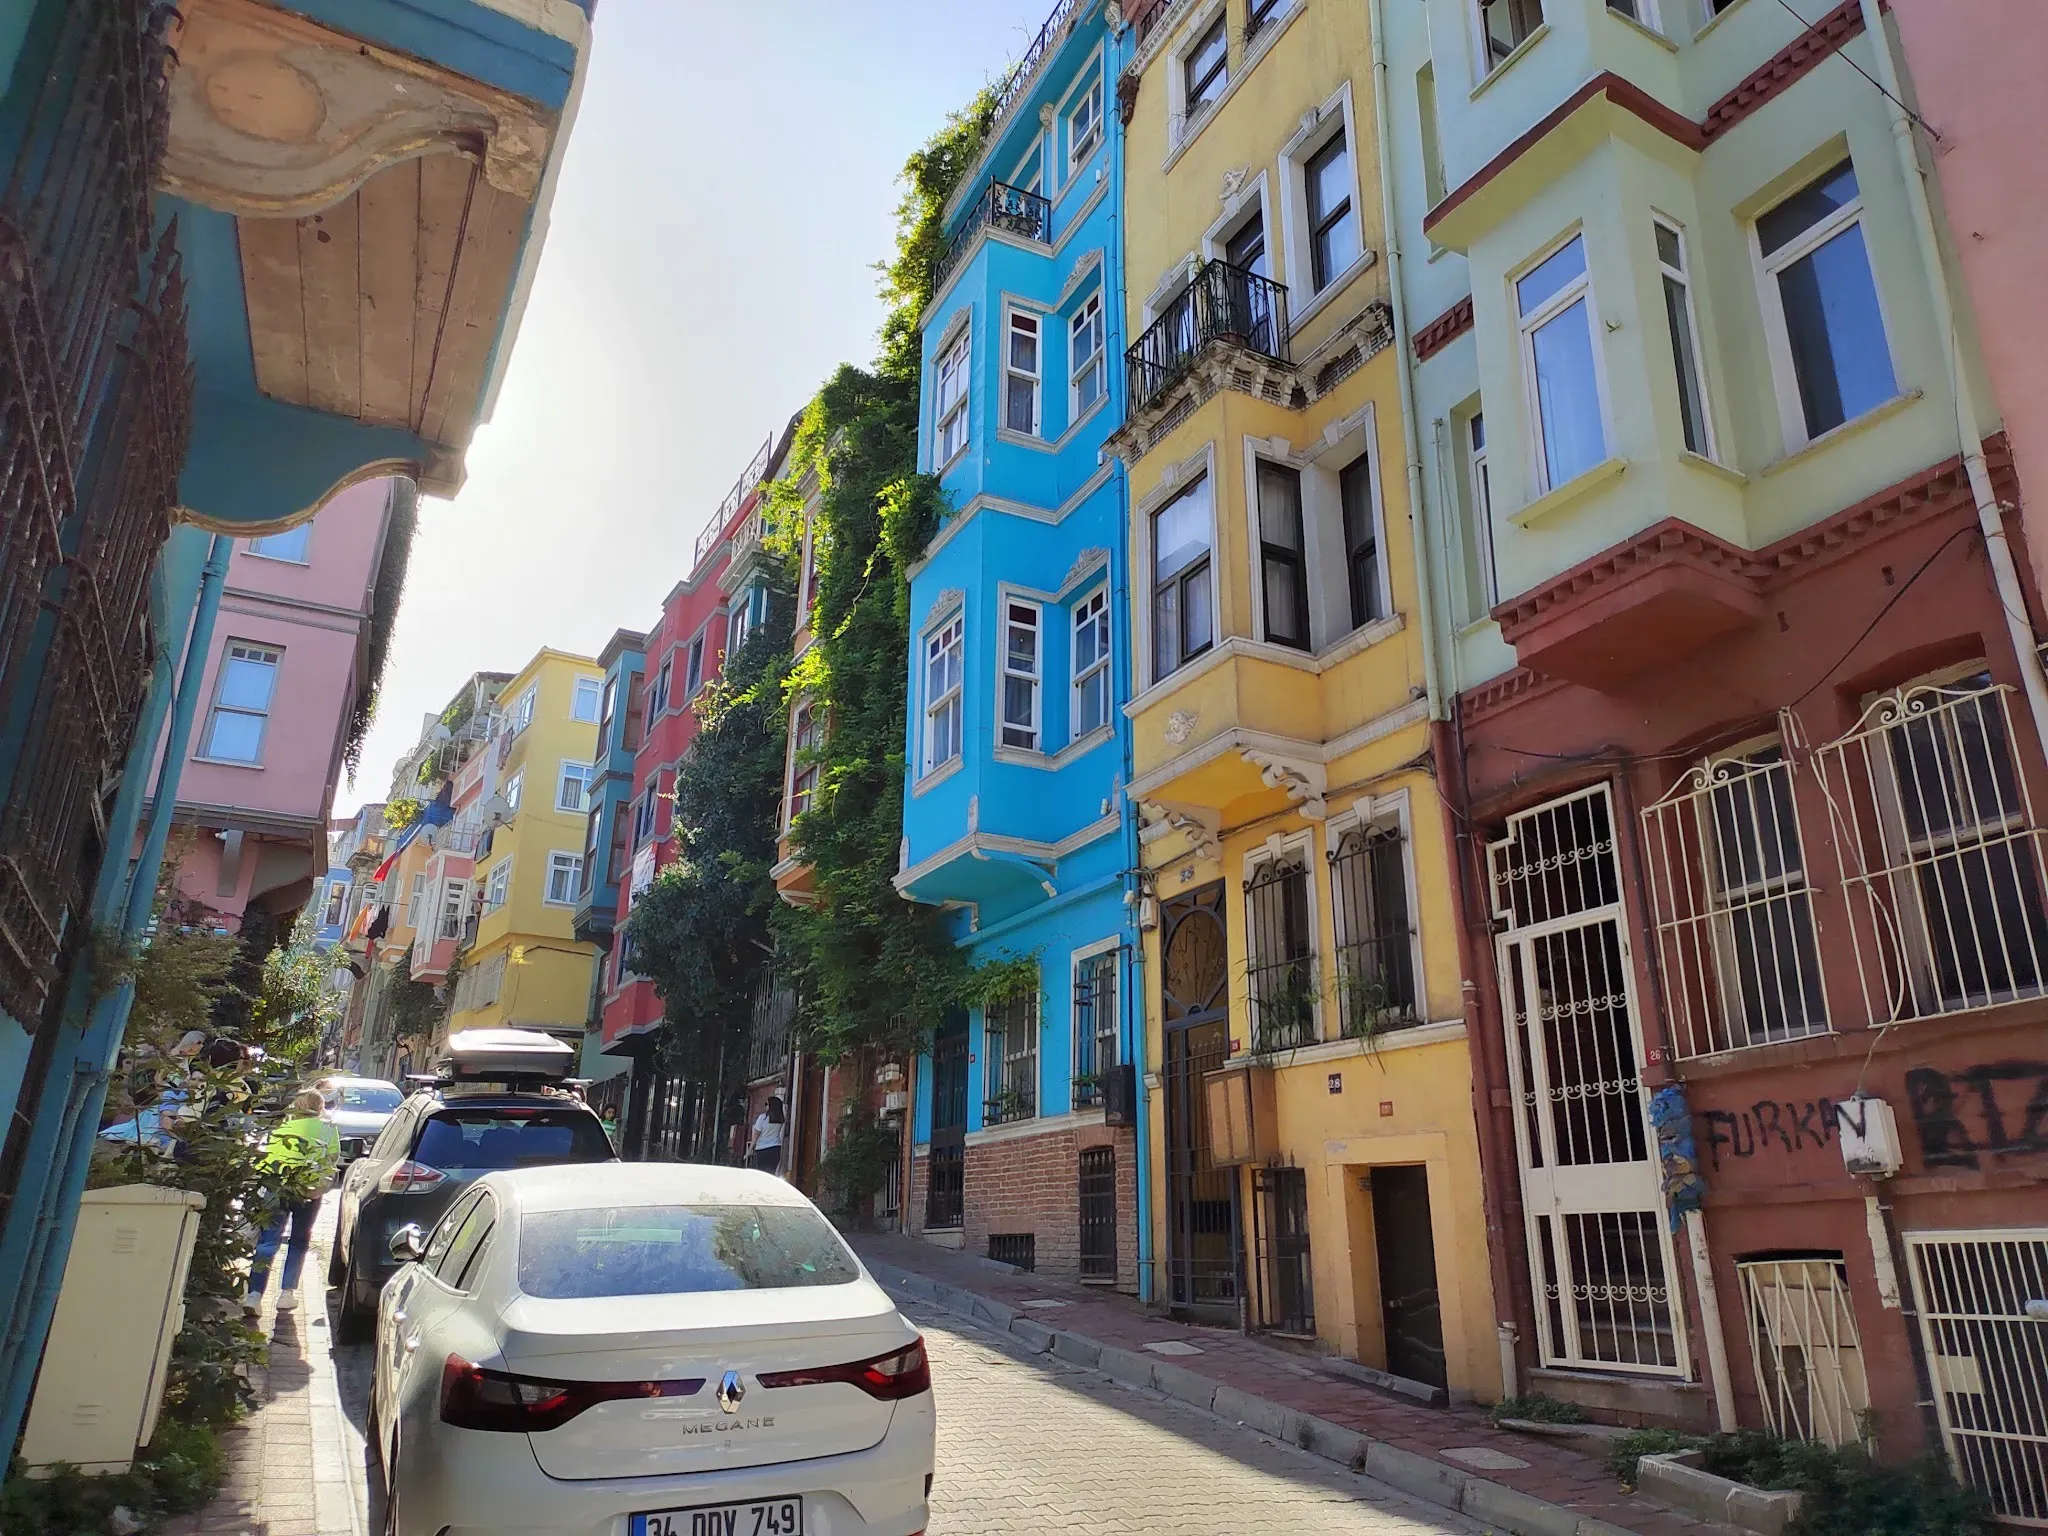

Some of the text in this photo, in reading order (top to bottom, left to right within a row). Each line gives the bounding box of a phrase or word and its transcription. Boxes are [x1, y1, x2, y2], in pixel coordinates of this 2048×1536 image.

[1650, 1050, 1661, 1061] 26
[1328, 1078, 1341, 1089] 28
[1700, 1098, 1866, 1172] FURKAN
[682, 1416, 775, 1435] MEGANE
[648, 1516, 676, 1536] 34
[751, 1504, 795, 1536] 749
